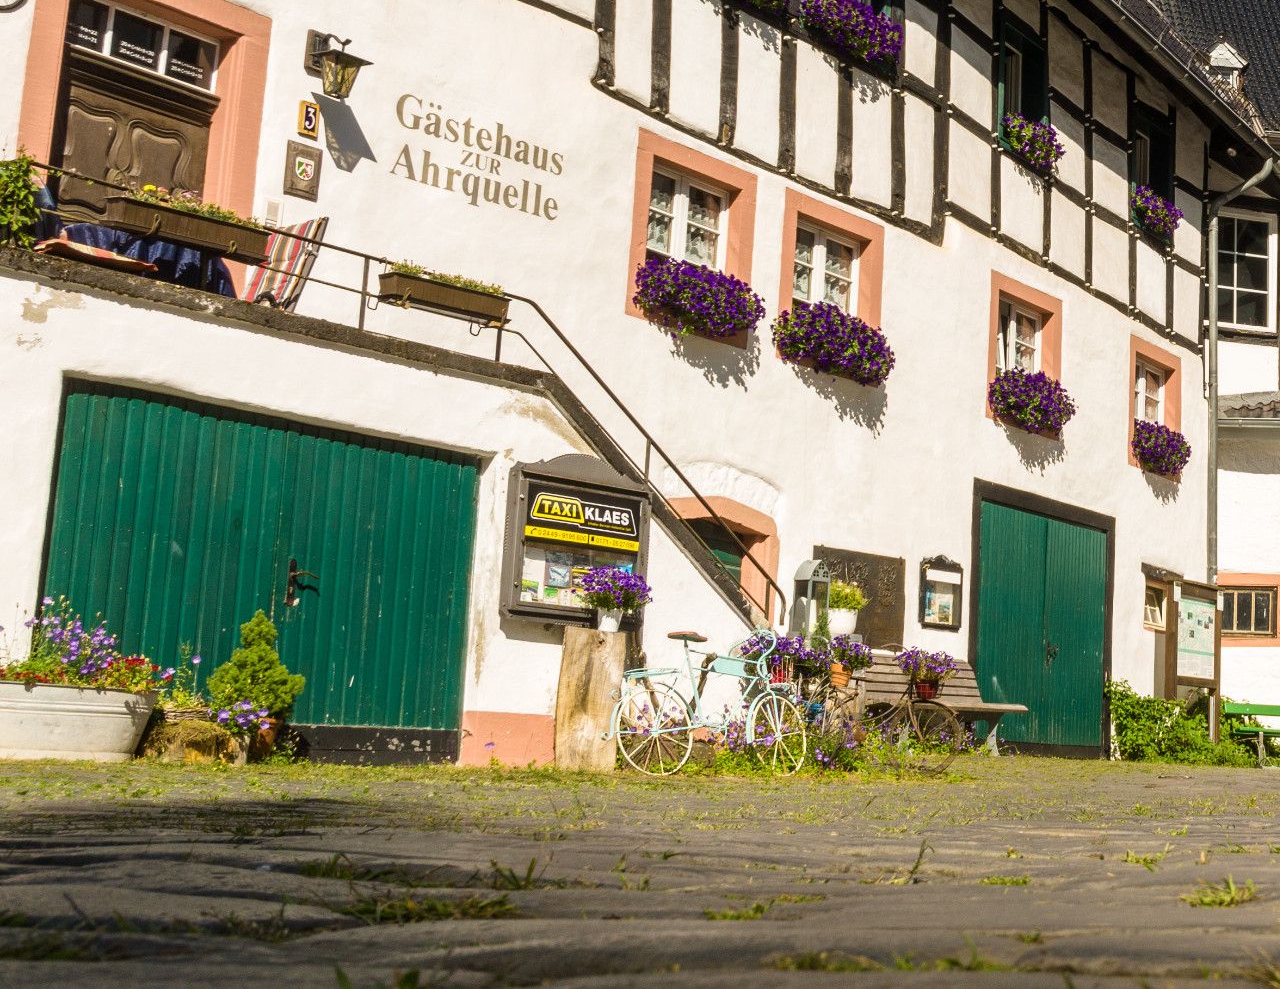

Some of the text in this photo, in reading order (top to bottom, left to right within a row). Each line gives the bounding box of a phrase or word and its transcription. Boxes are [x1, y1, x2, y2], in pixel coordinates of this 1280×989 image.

[304, 107, 316, 130] 3
[396, 93, 564, 176] Gästehaus
[460, 149, 501, 176] ZUR
[389, 143, 559, 221] Ahrquelle
[541, 499, 577, 518] TAXI
[584, 506, 630, 526] KLAES
